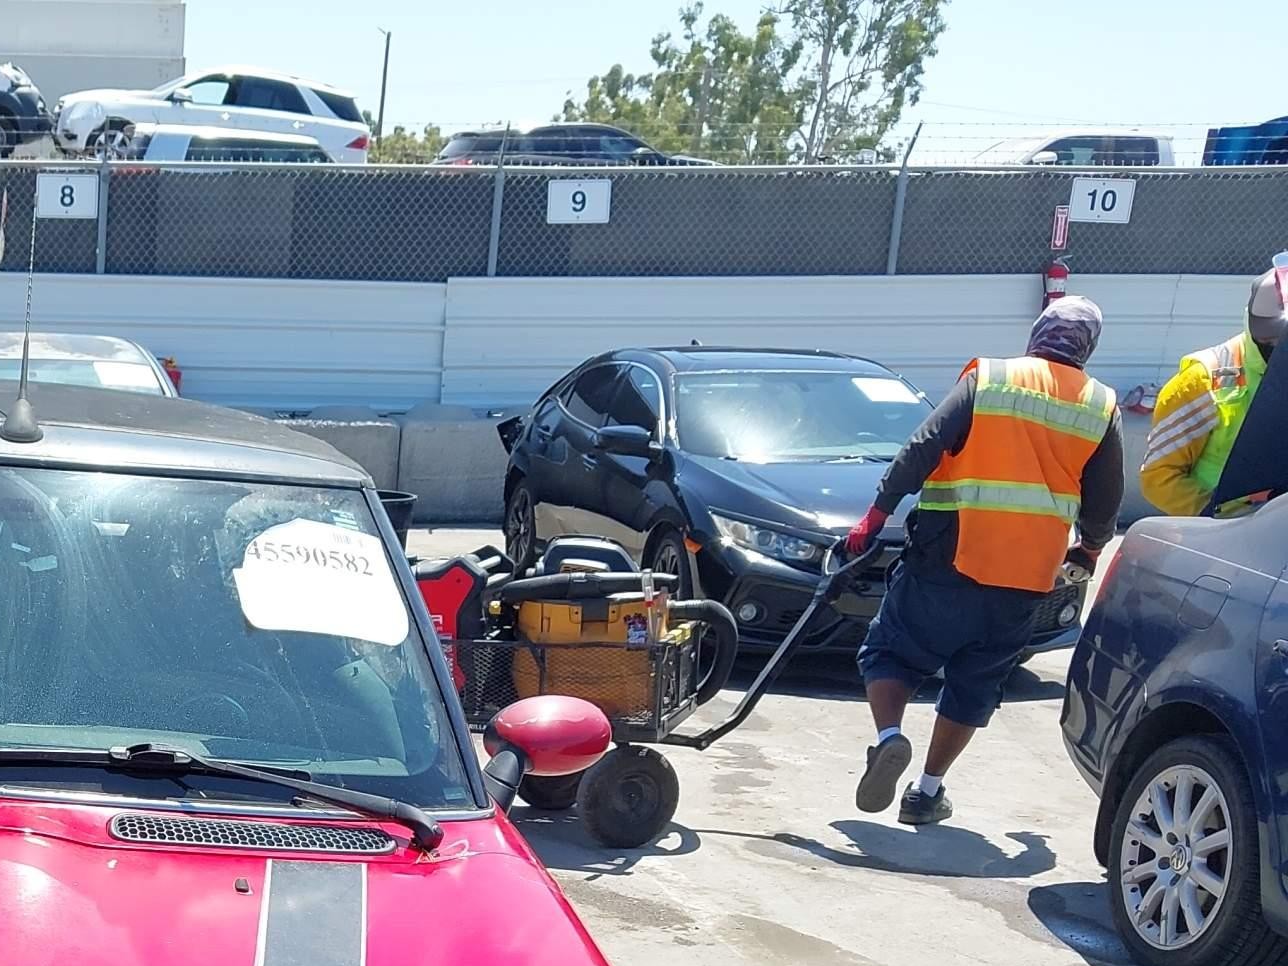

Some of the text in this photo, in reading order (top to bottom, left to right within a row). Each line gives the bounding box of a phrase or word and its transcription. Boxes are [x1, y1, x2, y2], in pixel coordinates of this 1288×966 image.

[60, 184, 75, 208] 8
[571, 190, 587, 213] 9
[1087, 188, 1118, 212] 10
[247, 540, 374, 577] 45590582
